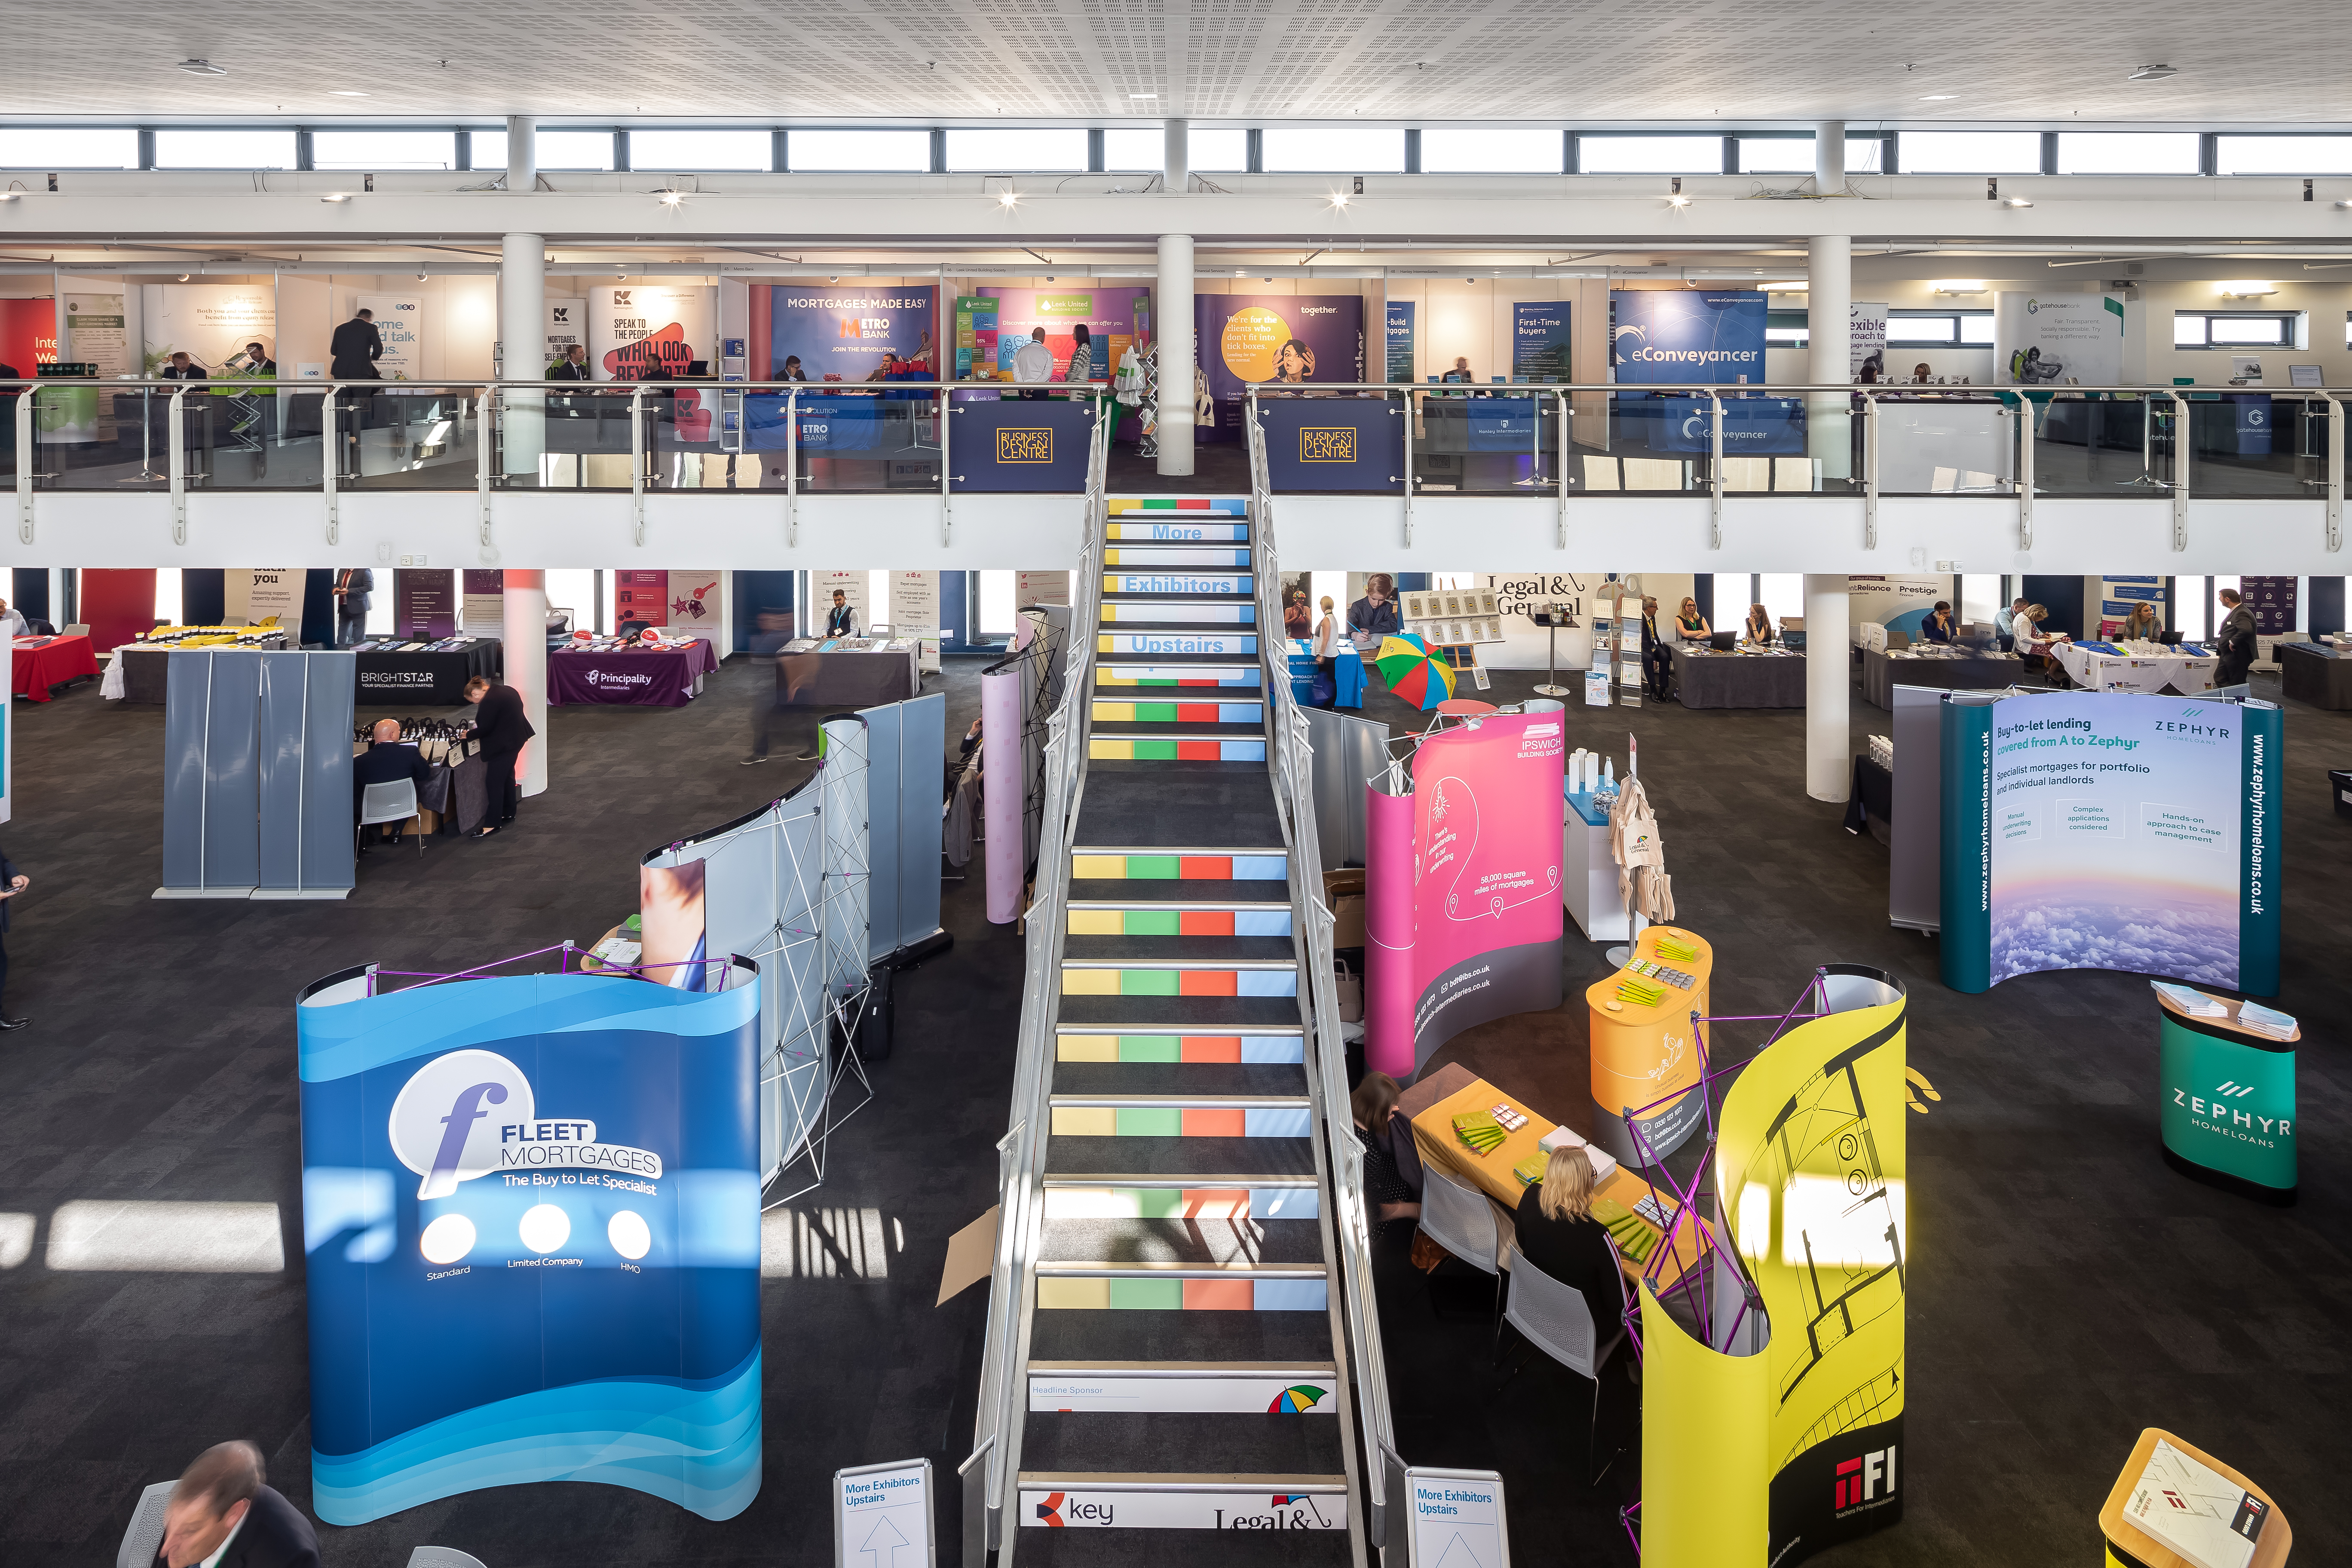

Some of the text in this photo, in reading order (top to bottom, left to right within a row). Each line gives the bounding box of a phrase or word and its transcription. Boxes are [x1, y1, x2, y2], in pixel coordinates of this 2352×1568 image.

[787, 298, 926, 309] MORTGAGES MADE EASY
[1301, 306, 1338, 316] together.
[614, 319, 646, 328] SPEAK TO
[614, 330, 627, 339] THE
[863, 331, 890, 339] BANK
[1519, 327, 1546, 335] Buyers
[1632, 347, 1758, 366] eConveyancer
[1001, 432, 1048, 441] BUSINESS
[1305, 432, 1352, 440] BUSINESS
[1001, 439, 1048, 450] DESIGN
[1305, 439, 1352, 448] DESIGN
[1001, 448, 1048, 459] CENTRE
[1305, 447, 1352, 458] CENTRE
[1153, 525, 1202, 539] More
[253, 573, 279, 586] you
[1126, 577, 1231, 592] Exhibitors
[1488, 575, 1571, 600] Legal &
[1899, 586, 1937, 595] Prestige
[1132, 636, 1224, 653] Upstairs
[361, 673, 433, 682] BRIGHTSTAR
[601, 674, 652, 685] Principality
[1997, 718, 2092, 739] Buy-to-let lending
[2155, 720, 2230, 739] ZEPHYR
[1522, 737, 1561, 750] IPSWICH
[1997, 734, 2140, 756] covered from A to Zephyr
[2167, 735, 2216, 746] HOMELOANS
[1546, 746, 1563, 756] SOCIETY
[1997, 761, 2150, 781] Specialist mortgages for portfolio
[1997, 775, 2094, 796] and individual landlords
[2007, 811, 2025, 821] Manual
[2073, 806, 2104, 815] Complex
[1981, 731, 1989, 911] www.zephyrhomeloans.co.uk
[2002, 818, 2031, 830] underwriting
[2067, 815, 2110, 823] applications
[2162, 812, 2204, 824] Hands-on
[2249, 734, 2266, 915] www.zephyrhomeloans.co.uk
[1435, 827, 1448, 841] There's
[2005, 829, 2027, 839] decisions
[2147, 820, 2187, 833] approach
[2200, 827, 2221, 836] case
[2155, 830, 2212, 843] management
[1428, 833, 1456, 856] understanding
[1430, 853, 1454, 873] underwriting
[1481, 870, 1526, 884] 58,000 square
[1474, 885, 1489, 895] miles
[1498, 879, 1534, 889] mortgages
[1414, 979, 1490, 1044] www.ipswich-intermediaries.co.uk
[1655, 1072, 1679, 1090] Unusual business
[1655, 1118, 1666, 1129] 0330
[1674, 1106, 1683, 1116] 1073
[2174, 1087, 2291, 1135] ZEPHYR
[501, 1124, 588, 1143] FLEET
[1655, 1118, 1682, 1140] bdt@ibs.co.uk
[2192, 1118, 2274, 1148] HOMELOANS
[502, 1146, 656, 1173] MORTGAGES
[502, 1173, 657, 1195] The Buy to Let Specialist
[507, 1258, 583, 1268] Limited Company
[621, 1263, 640, 1274] HMO
[426, 1265, 471, 1281] Standard
[1032, 1386, 1103, 1395] Headline Sponsor
[846, 1478, 920, 1494] More Exhibitors
[846, 1493, 885, 1507] Upstairs
[1418, 1488, 1491, 1503] More Exhibitors
[1069, 1498, 1114, 1526] key
[1419, 1502, 1458, 1515] Upstairs
[1836, 1509, 1855, 1519] Teachers
[1865, 1495, 1895, 1510] Intermediaries
